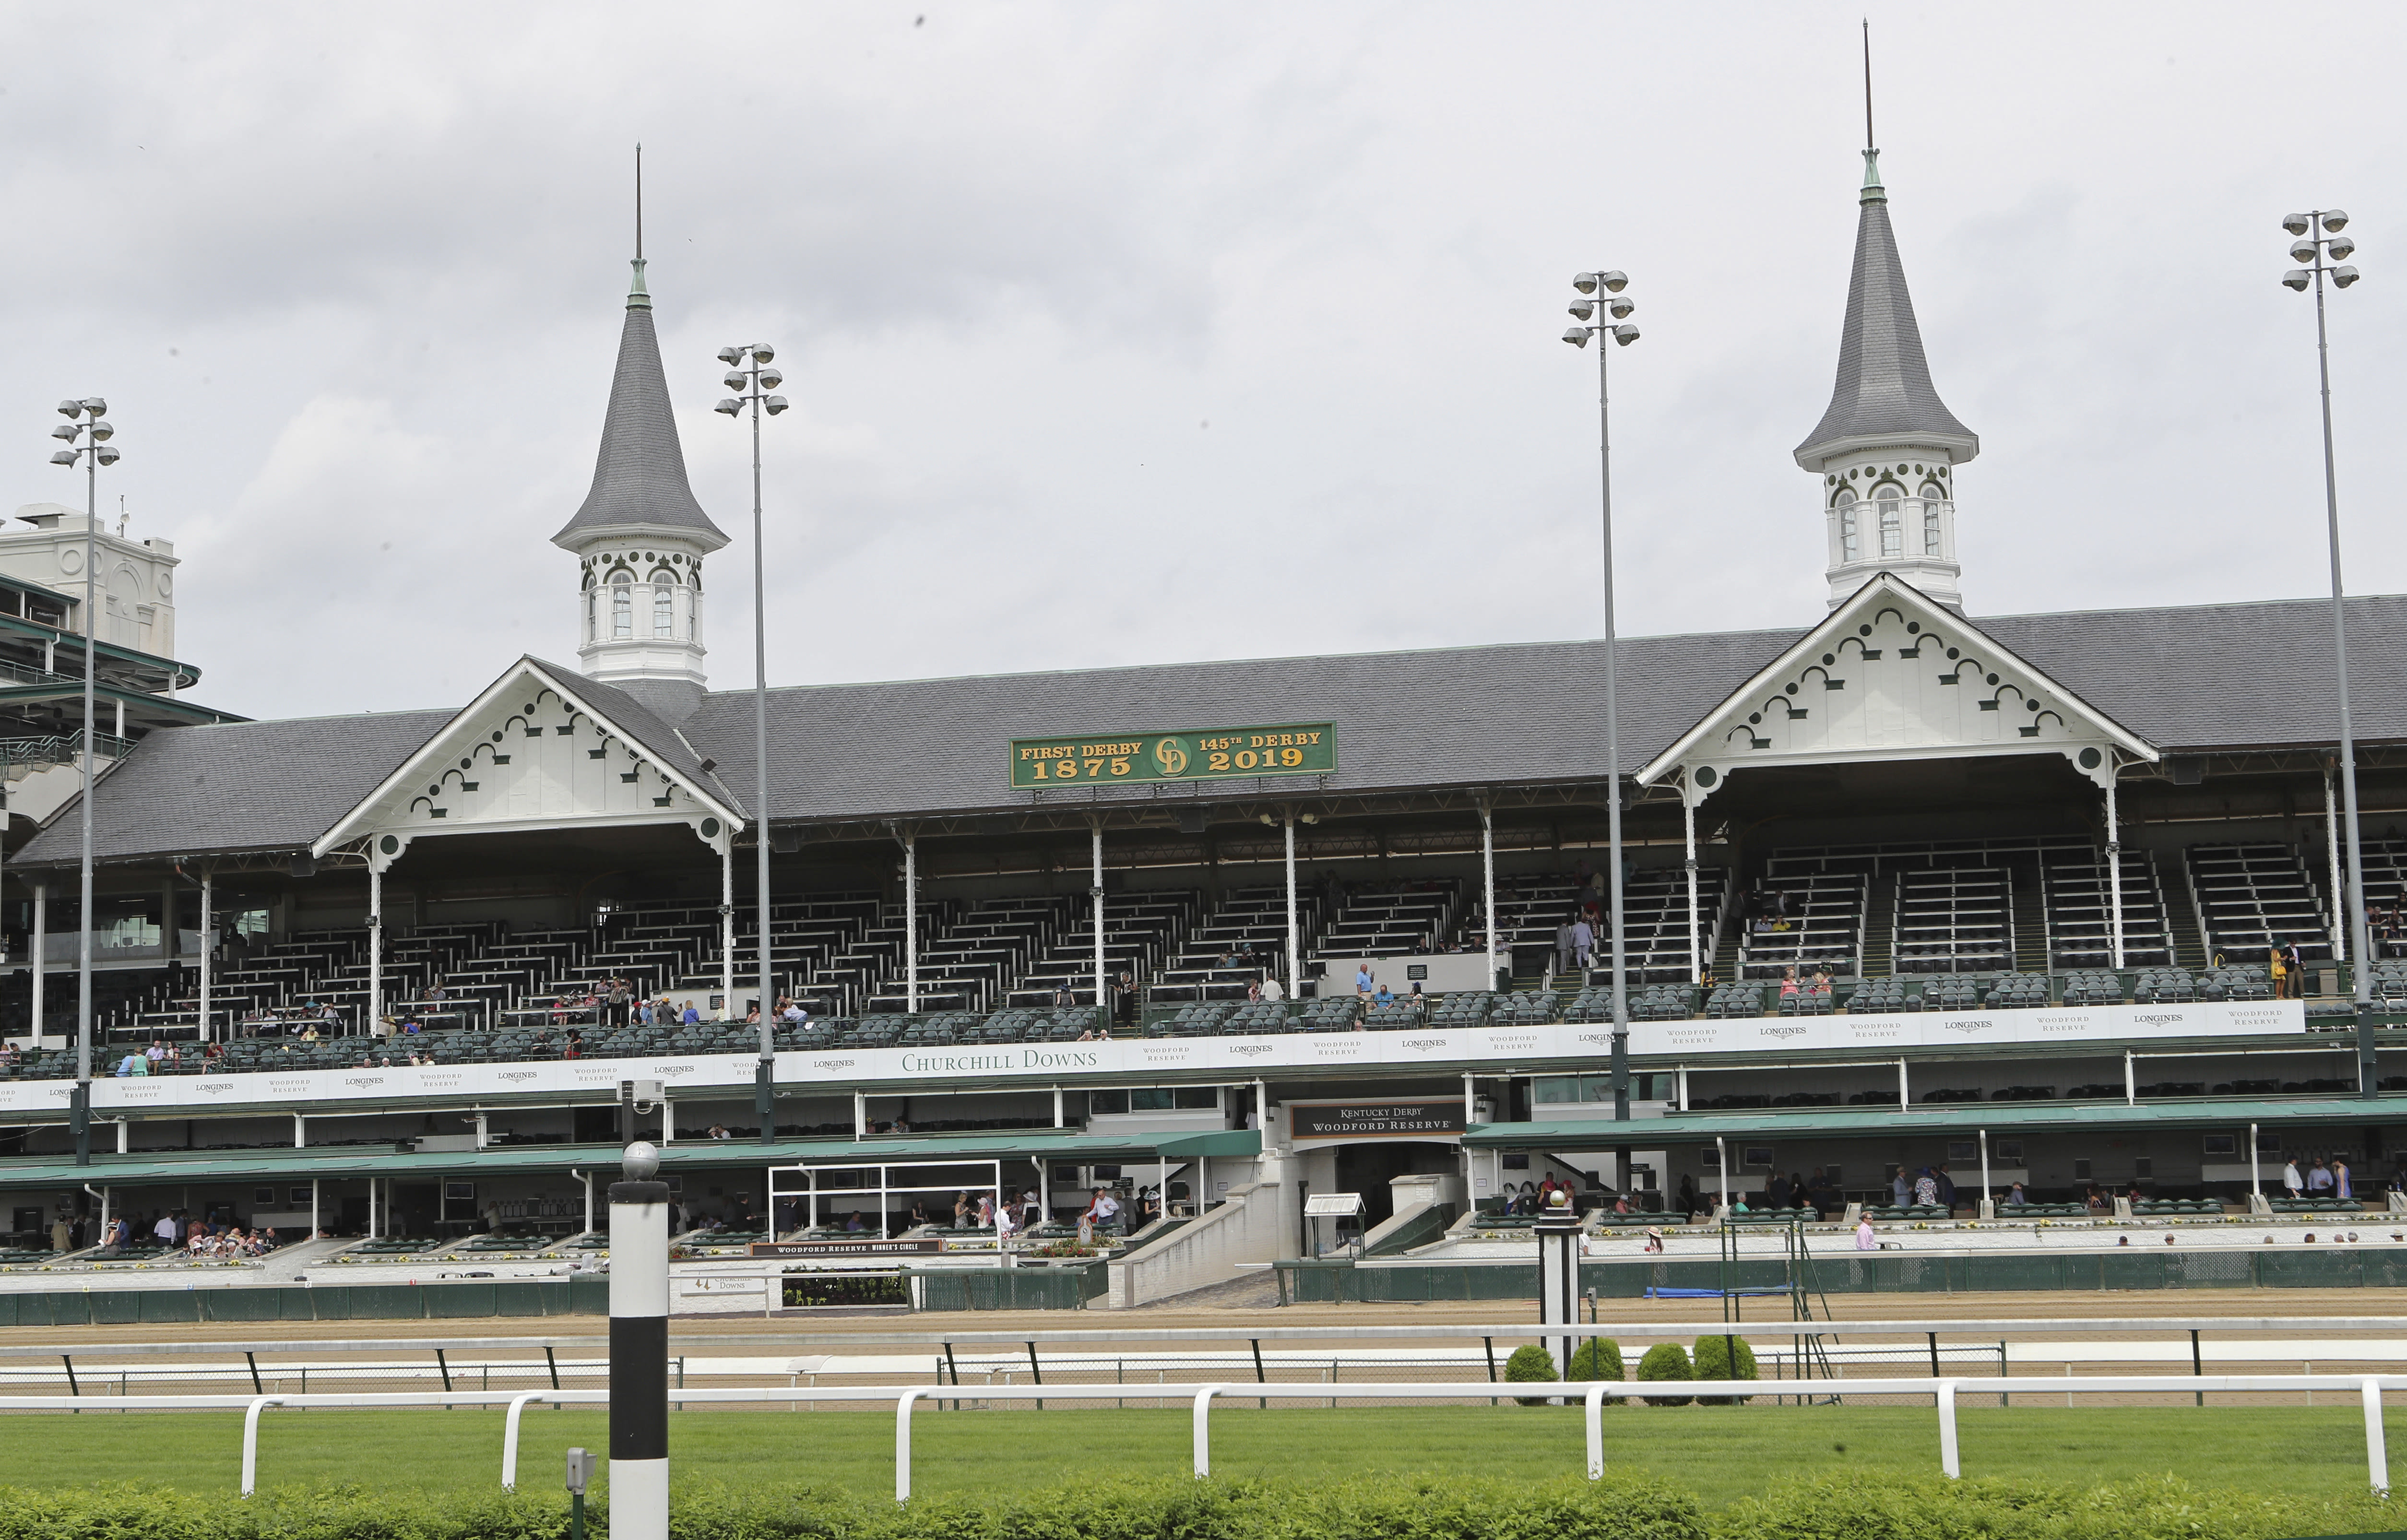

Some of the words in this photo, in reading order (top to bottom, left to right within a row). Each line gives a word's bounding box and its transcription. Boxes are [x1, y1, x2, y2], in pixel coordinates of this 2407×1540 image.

[1199, 737, 1243, 751] 145TH
[1250, 732, 1321, 748] DERBY
[1021, 746, 1075, 760] FIRST
[1081, 742, 1142, 757] DERBY
[1208, 747, 1304, 771] 2019
[1033, 757, 1131, 780] 1875
[2134, 1014, 2182, 1022] LONGINES
[1945, 1020, 1992, 1029] LONGINES
[1402, 1039, 1446, 1047] LONGINES
[902, 1054, 1014, 1071] CHURCHILL
[1023, 1050, 1097, 1067] DOWNS
[1340, 1109, 1389, 1119] KENTUCKY
[1393, 1108, 1422, 1116] DERBY
[1313, 1123, 1385, 1131] WOODFORD
[1390, 1121, 1449, 1130] RESERVE
[777, 1245, 826, 1254] WOODFORD
[828, 1244, 866, 1253] RESERVE
